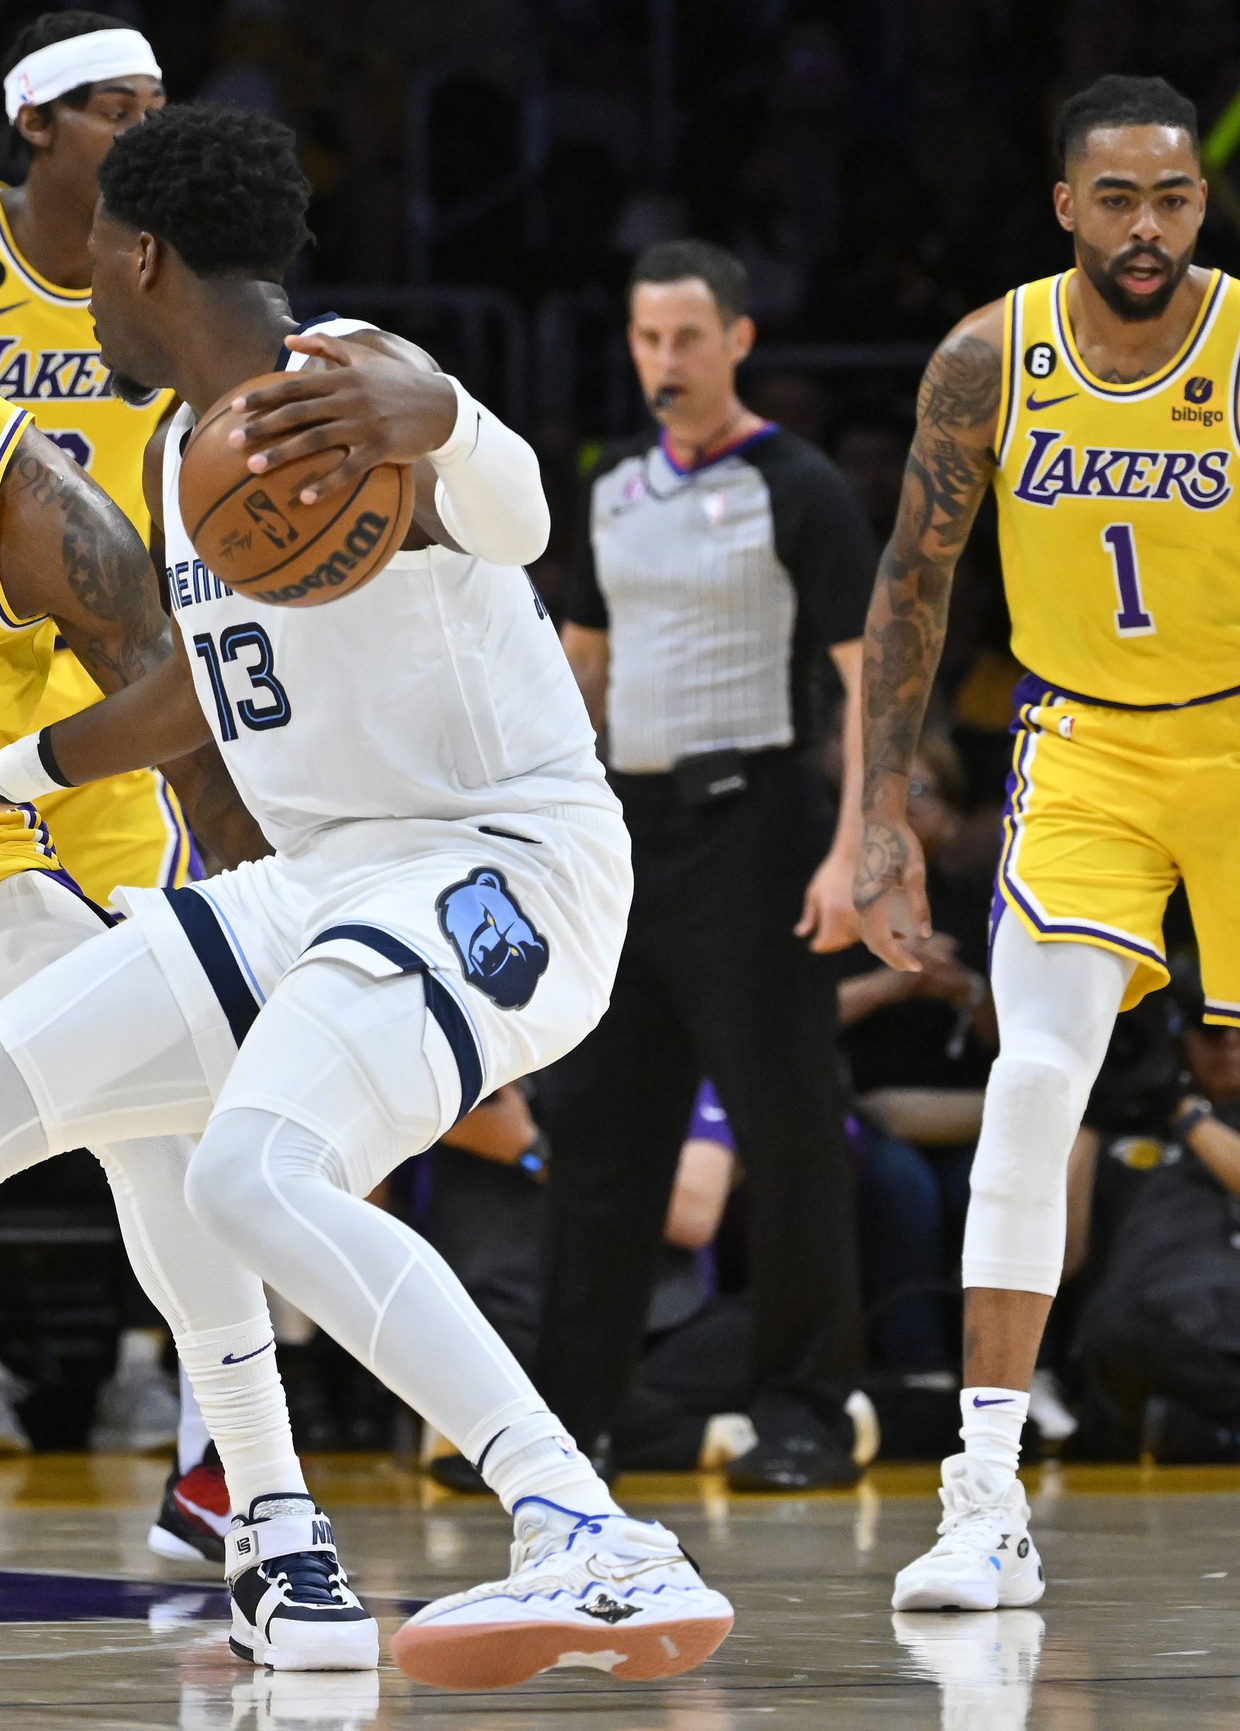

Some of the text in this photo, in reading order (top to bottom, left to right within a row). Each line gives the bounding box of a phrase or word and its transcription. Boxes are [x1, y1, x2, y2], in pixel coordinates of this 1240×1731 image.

[1030, 346, 1052, 376] 6
[1171, 407, 1224, 428] bibigo
[1013, 427, 1235, 512] LAKERS
[1101, 522, 1158, 638] 1
[192, 621, 292, 742] 13
